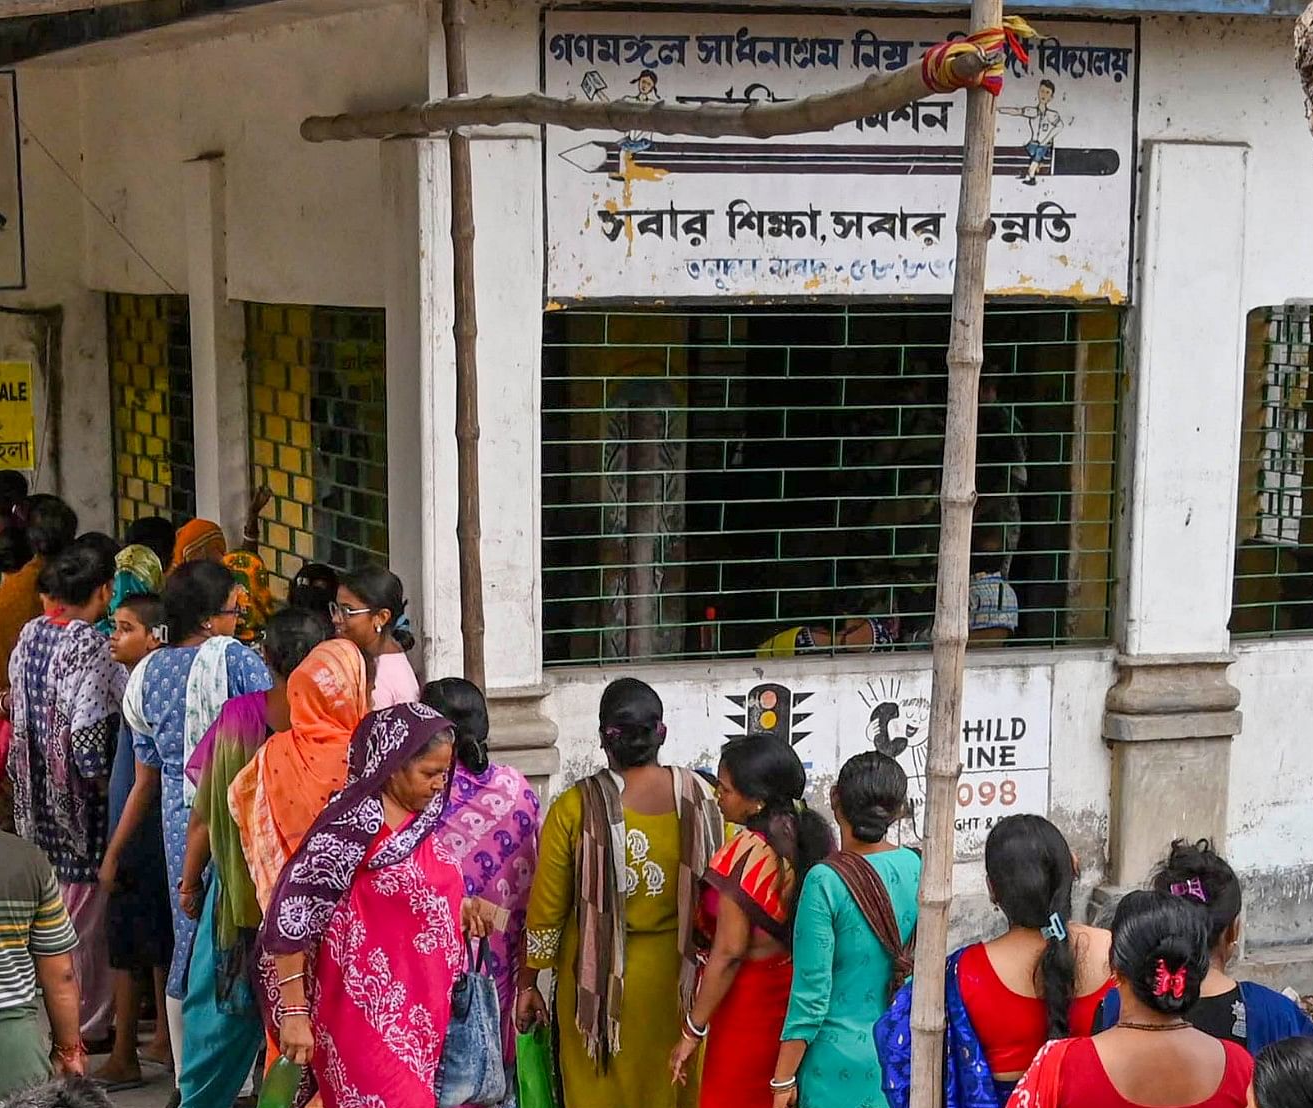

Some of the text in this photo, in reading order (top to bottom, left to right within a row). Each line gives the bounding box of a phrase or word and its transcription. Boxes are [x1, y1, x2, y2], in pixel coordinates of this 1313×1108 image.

[549, 34, 690, 69] গণমঙ্গল
[1038, 37, 1132, 83] বিদ্যালয়
[597, 200, 715, 246] সবার
[987, 201, 1076, 243] ন্নতি
[963, 717, 1027, 743] HILD
[967, 745, 1016, 769] INE
[957, 780, 1017, 807] 098
[954, 816, 981, 831] GHT
